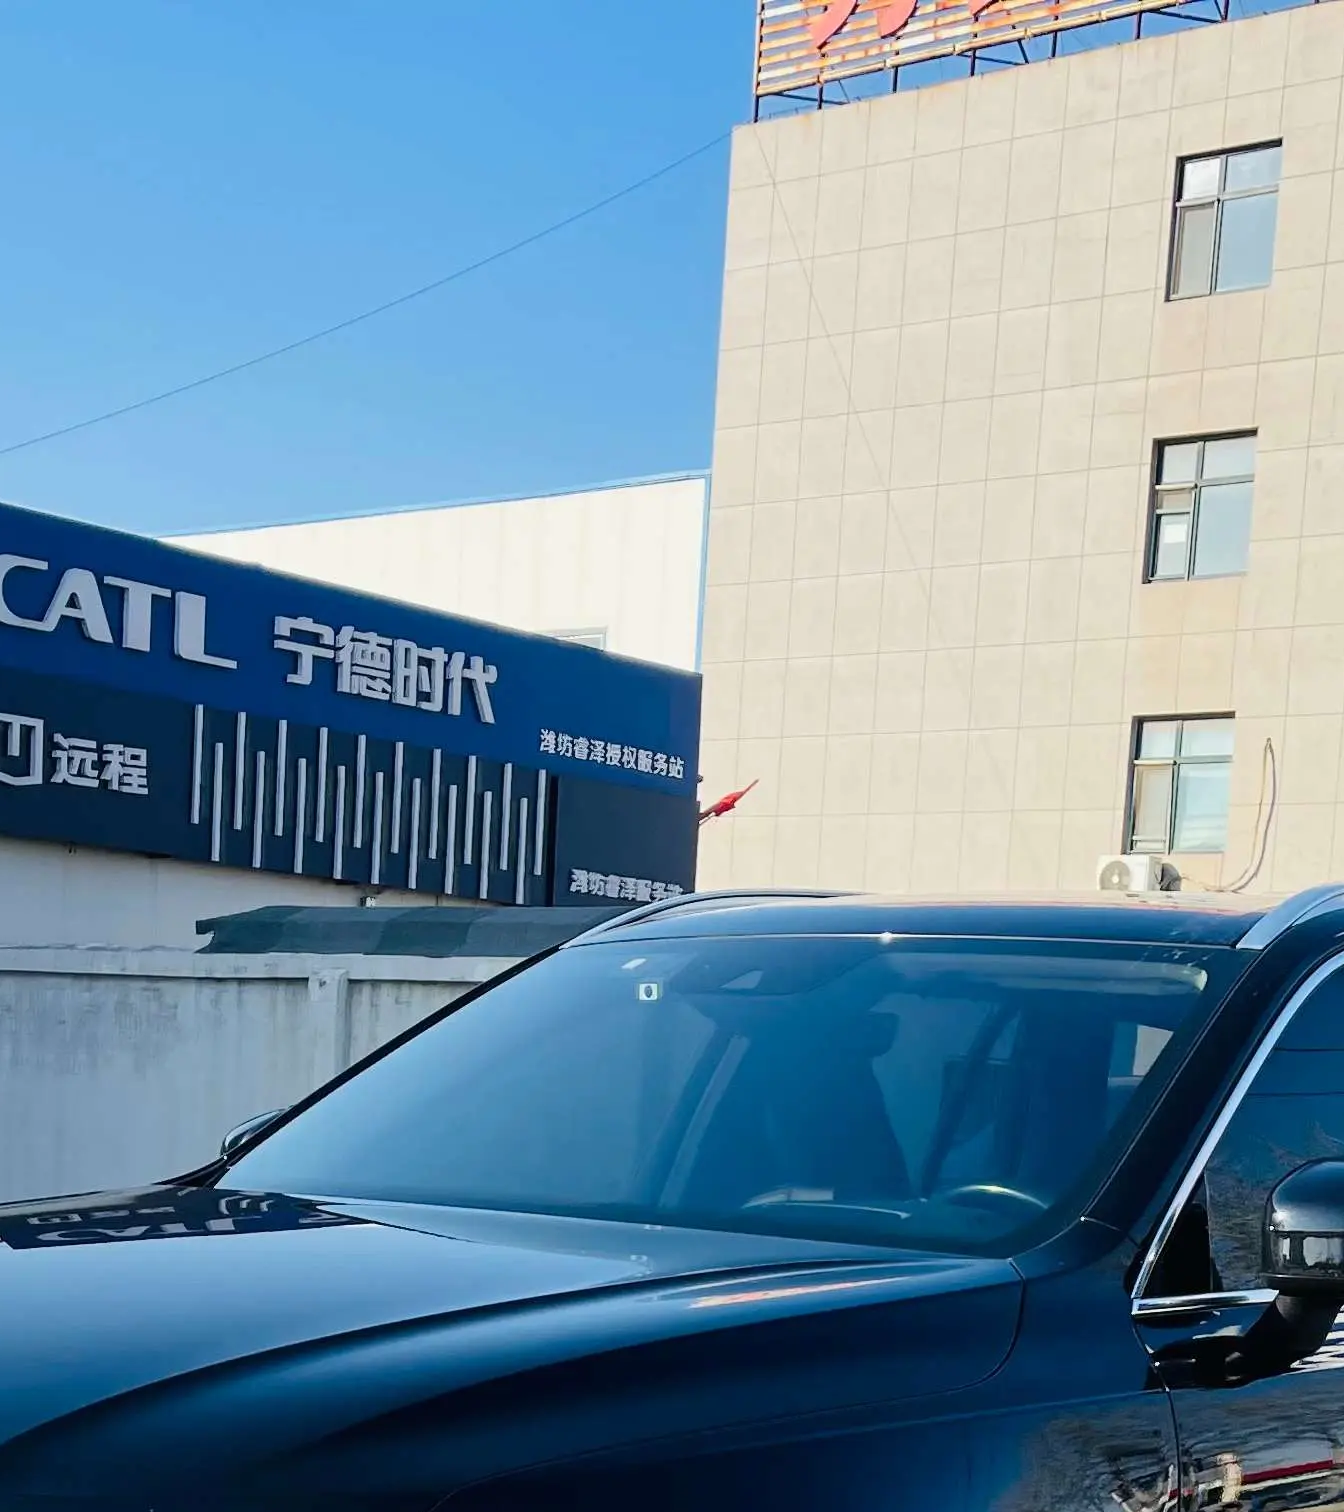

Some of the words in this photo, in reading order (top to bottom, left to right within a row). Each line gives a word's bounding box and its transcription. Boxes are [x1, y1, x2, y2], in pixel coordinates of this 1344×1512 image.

[272, 615, 498, 725] 宁德时代
[50, 733, 149, 795] 远程
[539, 728, 685, 779] 潍坊睿泽授权服务站
